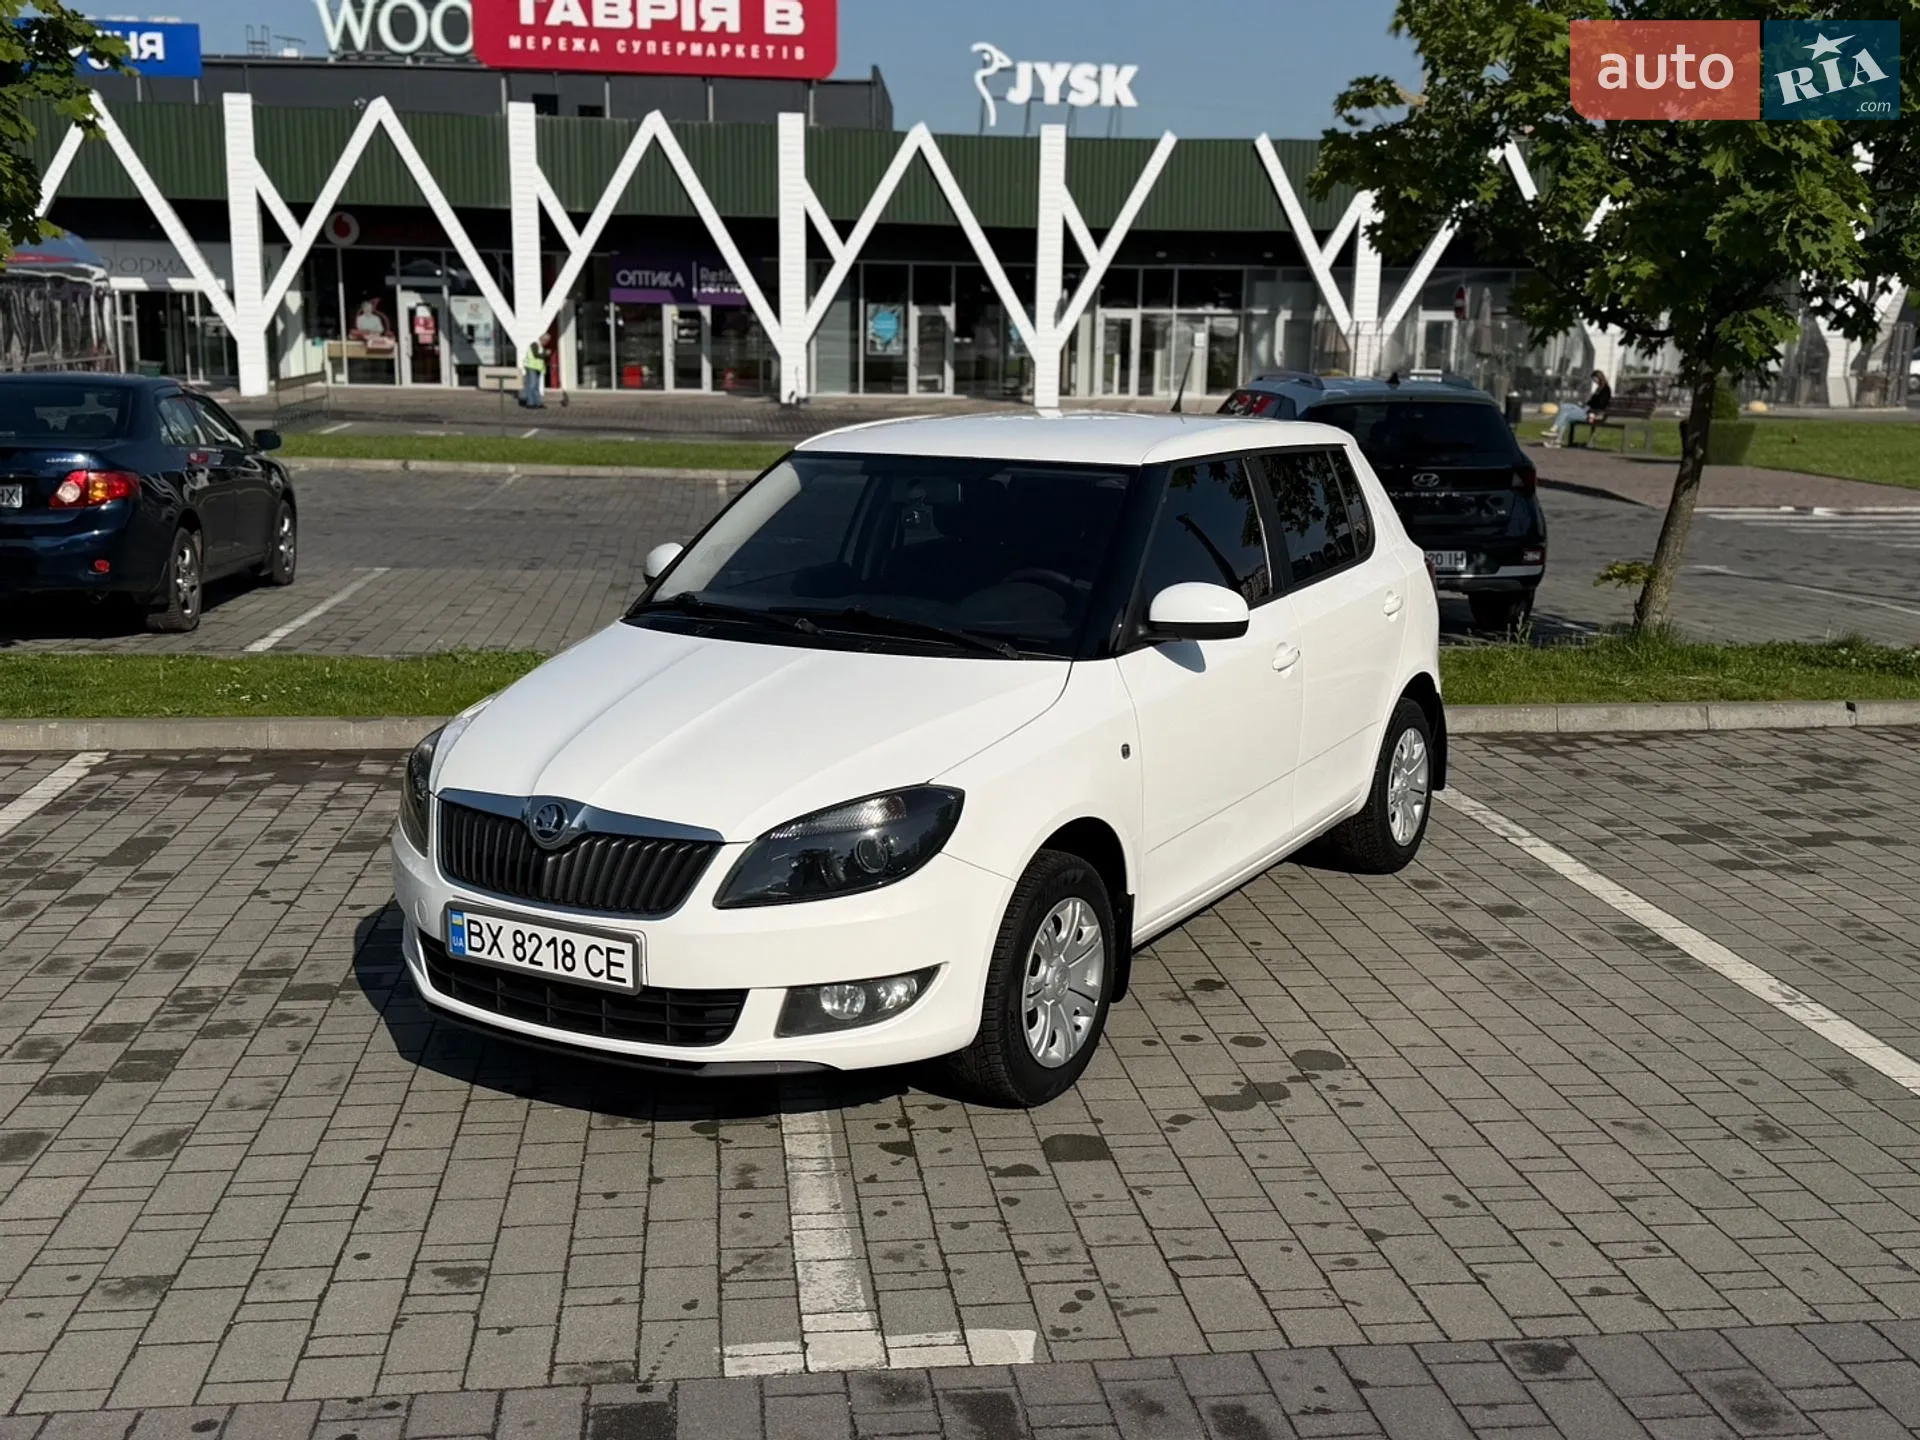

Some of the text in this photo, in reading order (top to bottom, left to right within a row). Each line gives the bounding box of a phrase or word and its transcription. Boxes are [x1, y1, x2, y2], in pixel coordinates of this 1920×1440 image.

[763, 0, 805, 36] В
[508, 34, 806, 60] МЕРЕЖА СУПЕРМАРКЕТІВ
[1006, 61, 1139, 107] JYSK
[616, 270, 685, 288] ОПТИКА
[700, 267, 733, 282] Retin
[700, 282, 743, 294] servic
[451, 935, 465, 947] UA
[467, 919, 627, 984] BX 8218 CE
